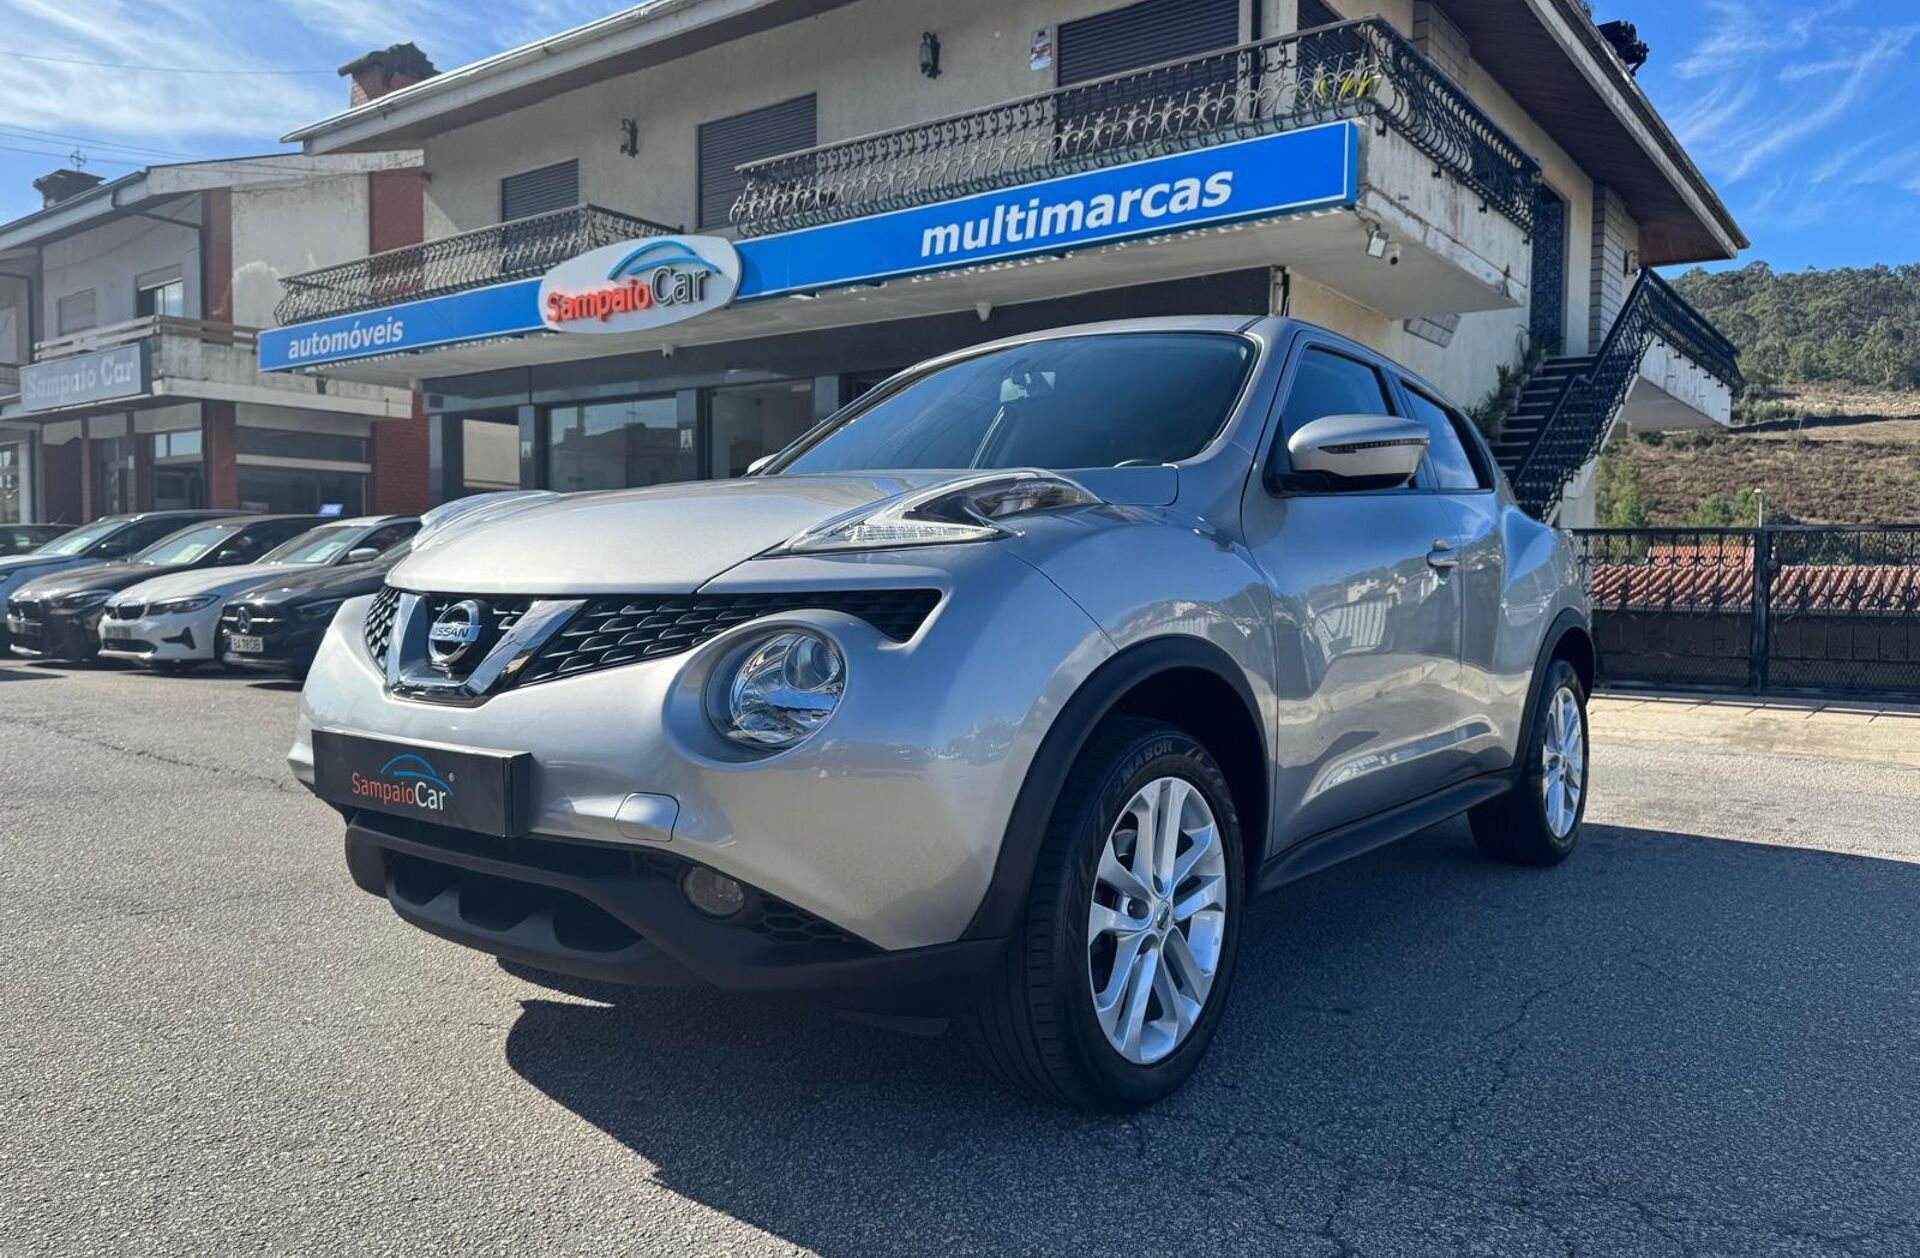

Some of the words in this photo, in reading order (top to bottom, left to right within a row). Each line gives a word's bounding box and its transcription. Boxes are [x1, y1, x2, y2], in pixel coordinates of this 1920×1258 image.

[921, 170, 1233, 257] multimarcas
[288, 316, 404, 359] automóveis
[25, 362, 98, 400] Sampaio
[100, 355, 135, 386] Car
[351, 771, 446, 811] SampaioCar
